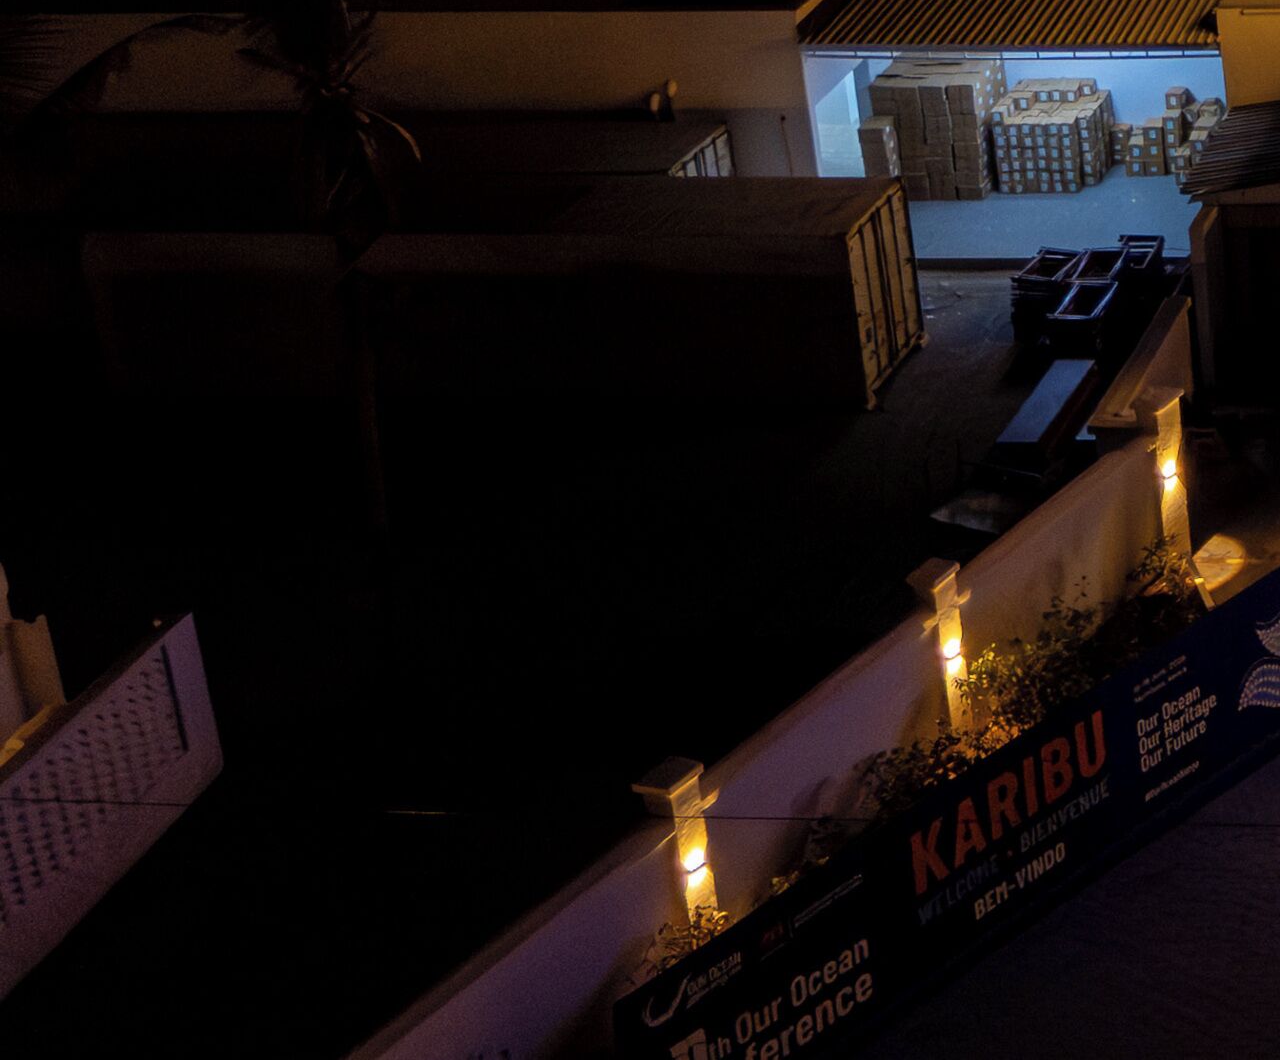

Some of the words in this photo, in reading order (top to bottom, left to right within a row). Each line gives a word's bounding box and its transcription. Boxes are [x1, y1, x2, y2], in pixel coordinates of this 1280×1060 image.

[1136, 713, 1160, 737] Our
[1163, 686, 1201, 720] Ocean
[1138, 732, 1162, 755] Our
[1165, 694, 1218, 736] Heritage
[1140, 749, 1164, 773] Our
[1166, 720, 1208, 756] Future
[910, 709, 1107, 899] KARIBU
[917, 855, 1000, 925] WELCOME
[1020, 773, 1111, 852] BIENVENUE
[974, 842, 1066, 921] BEM-VINDO
[735, 996, 782, 1044] Our
[789, 938, 870, 1008] Ocean
[743, 971, 873, 1060] ference
